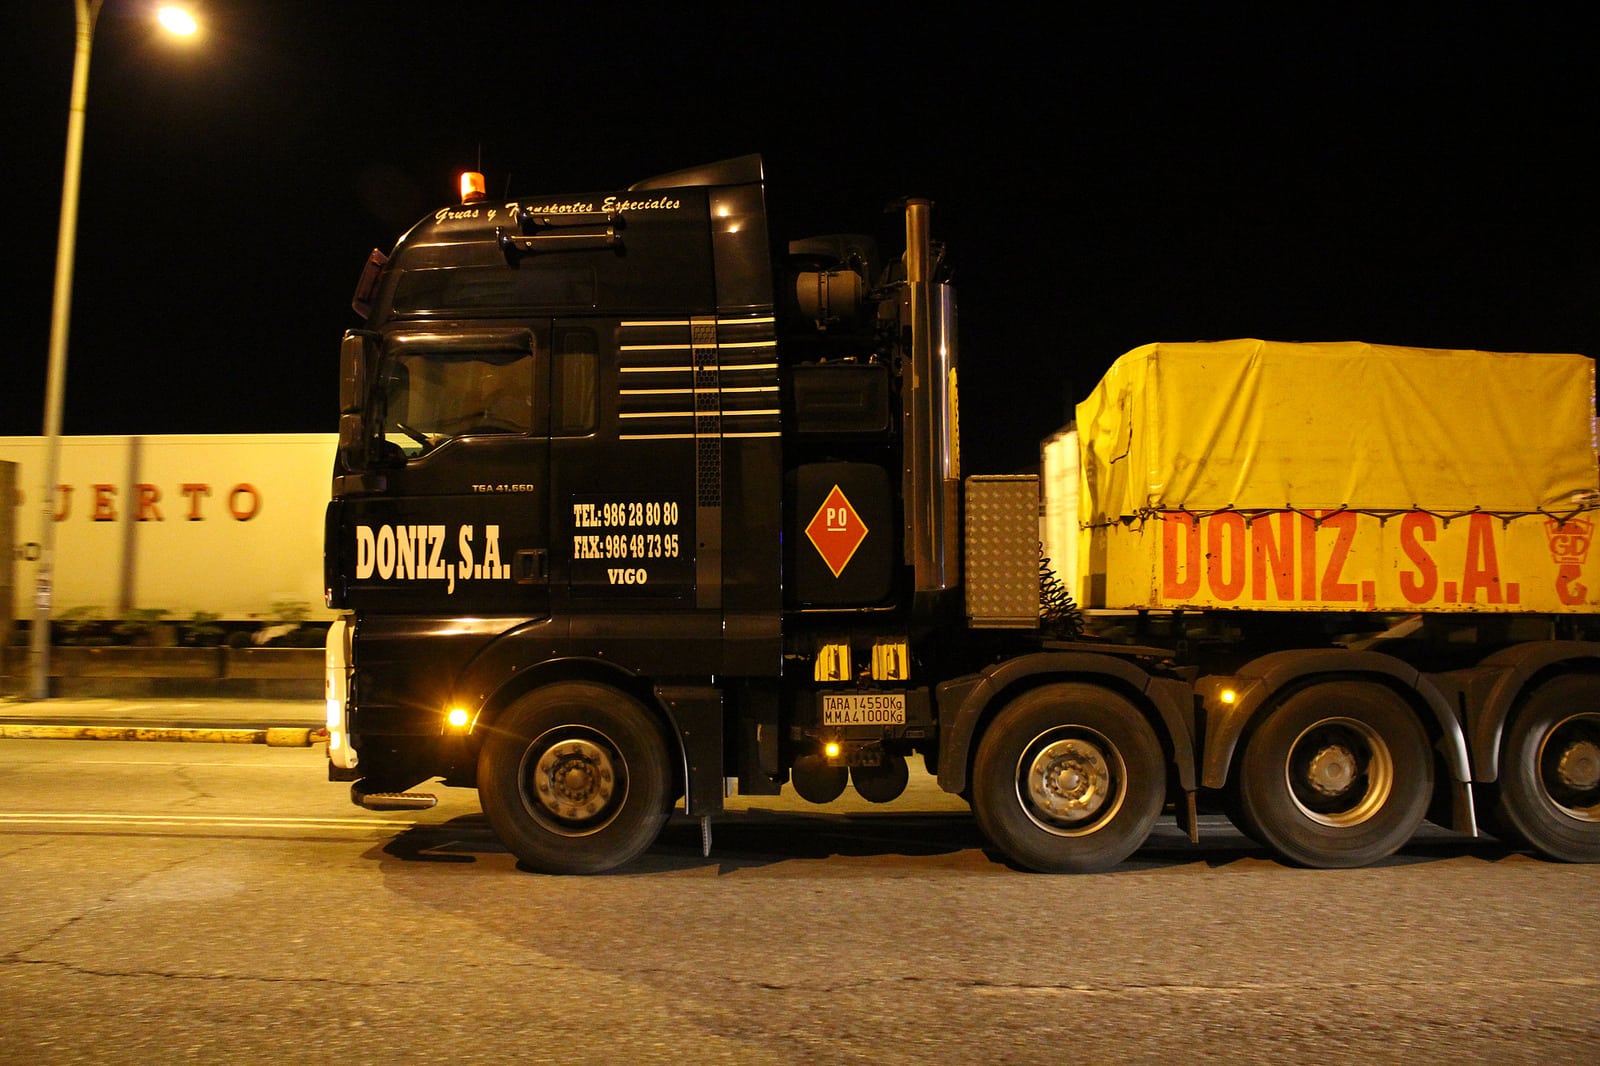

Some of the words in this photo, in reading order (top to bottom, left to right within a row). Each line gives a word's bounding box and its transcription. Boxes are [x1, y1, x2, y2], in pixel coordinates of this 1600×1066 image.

[435, 207, 480, 225] Gruas
[487, 209, 497, 222] y
[601, 196, 681, 214] Especiales
[472, 484, 494, 493] TGA
[495, 484, 535, 493] 41.660
[573, 503, 602, 528] TEL:
[603, 502, 626, 527] 986
[628, 502, 644, 526] 28
[645, 501, 661, 526] 80
[663, 501, 679, 526] 80
[573, 535, 604, 559] FAX:
[605, 534, 628, 559] 986
[630, 534, 645, 558] 48
[646, 534, 662, 558] 73
[664, 534, 679, 558] 95
[1399, 509, 1521, 605] S.A.
[607, 568, 648, 585] VIGO
[825, 697, 850, 710] TARA
